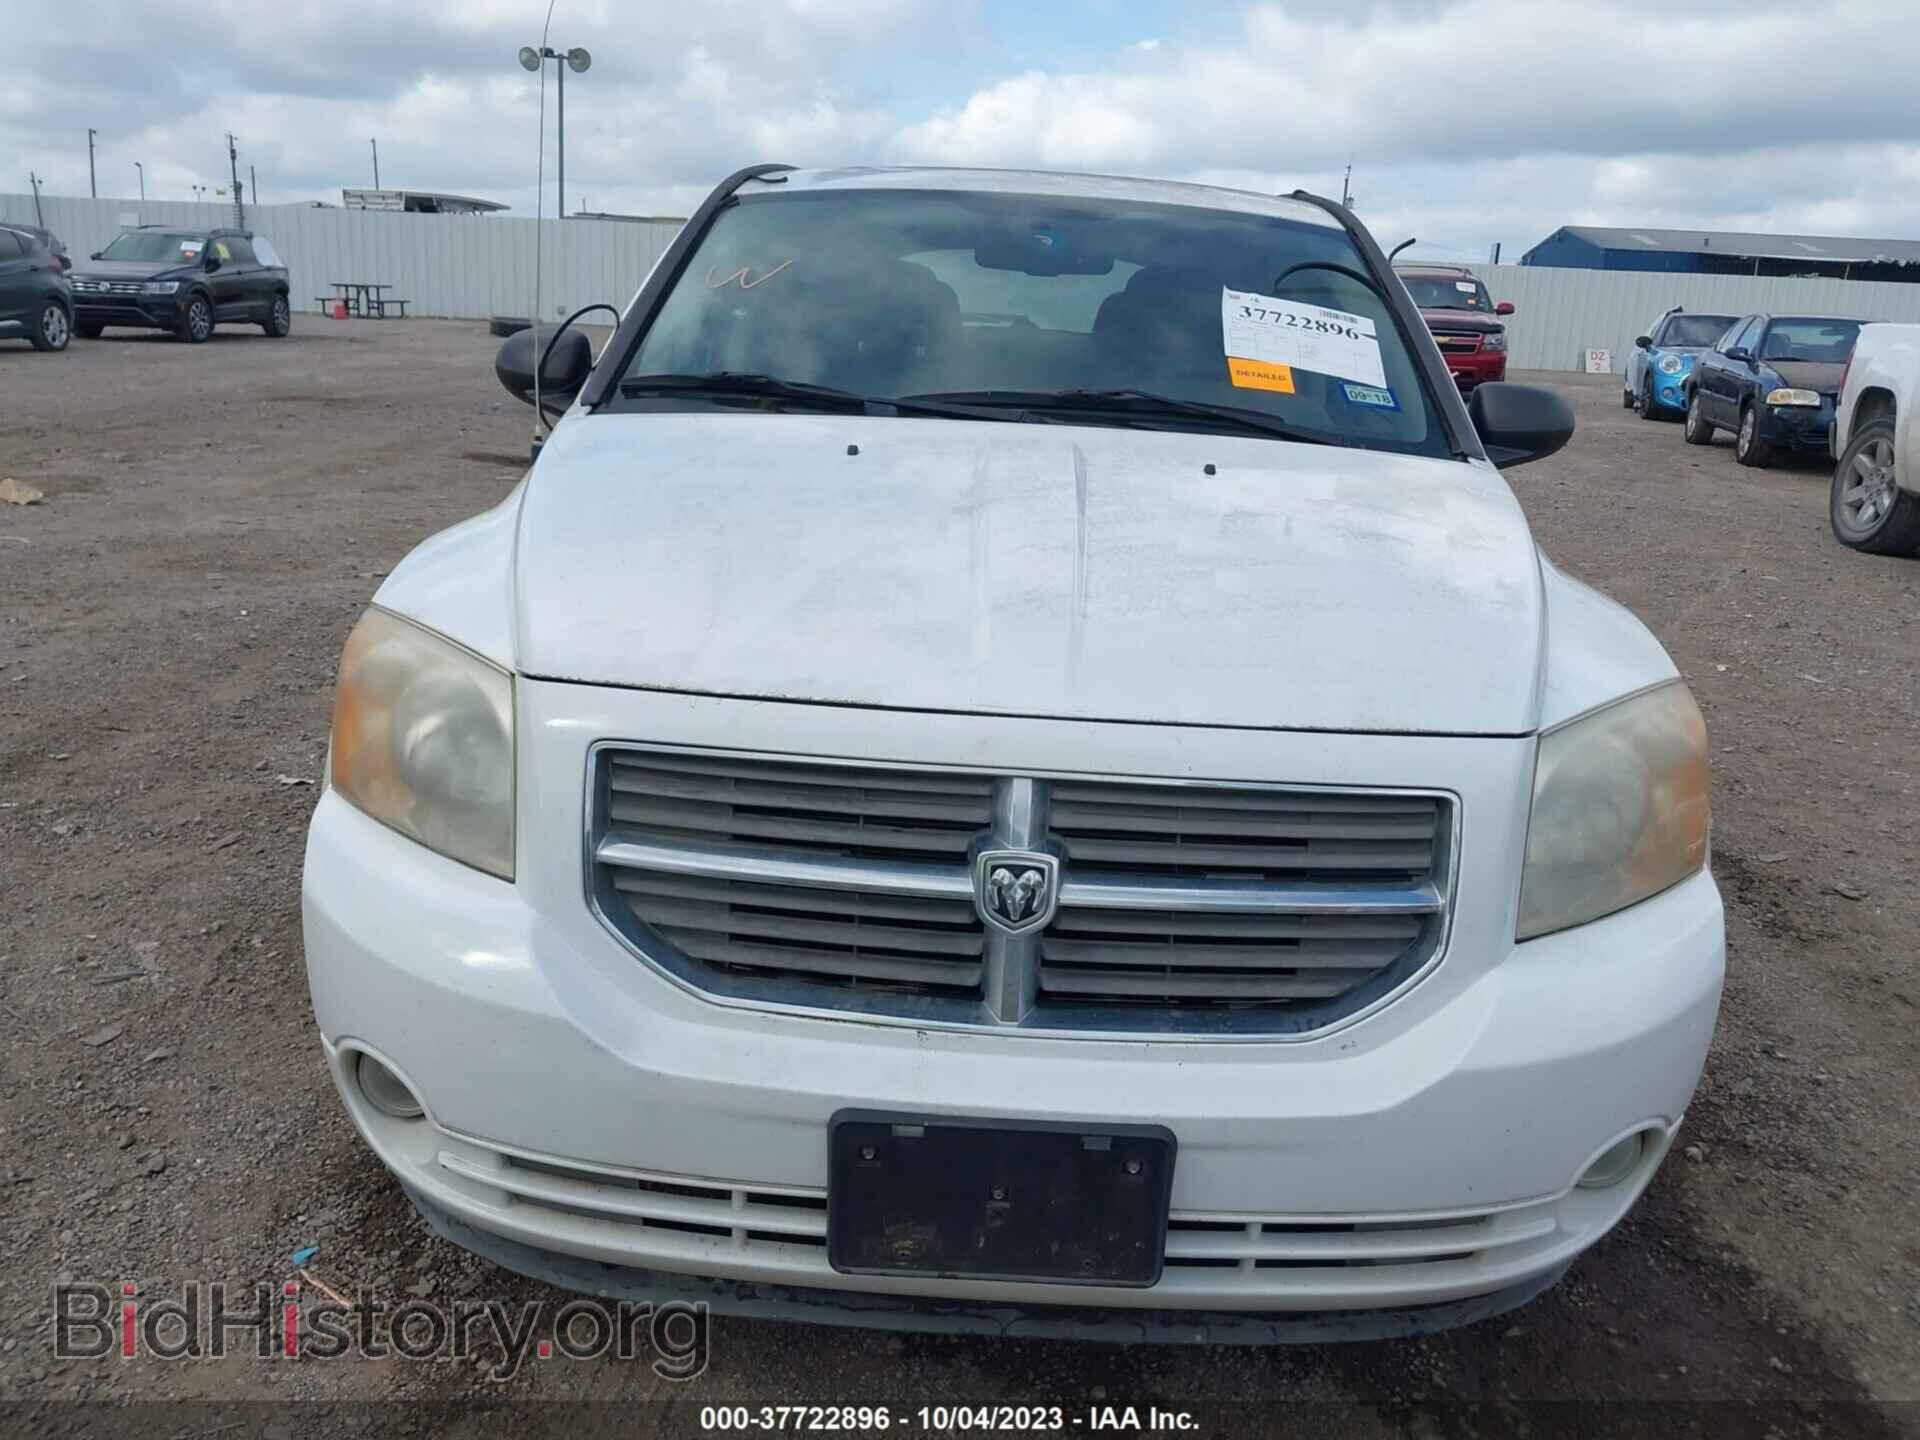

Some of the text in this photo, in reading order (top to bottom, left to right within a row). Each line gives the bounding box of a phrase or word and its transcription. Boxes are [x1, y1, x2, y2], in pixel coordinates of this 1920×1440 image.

[1238, 305, 1360, 341] 37722896
[1590, 351, 1606, 361] DZ
[1236, 370, 1287, 382] DETAILED
